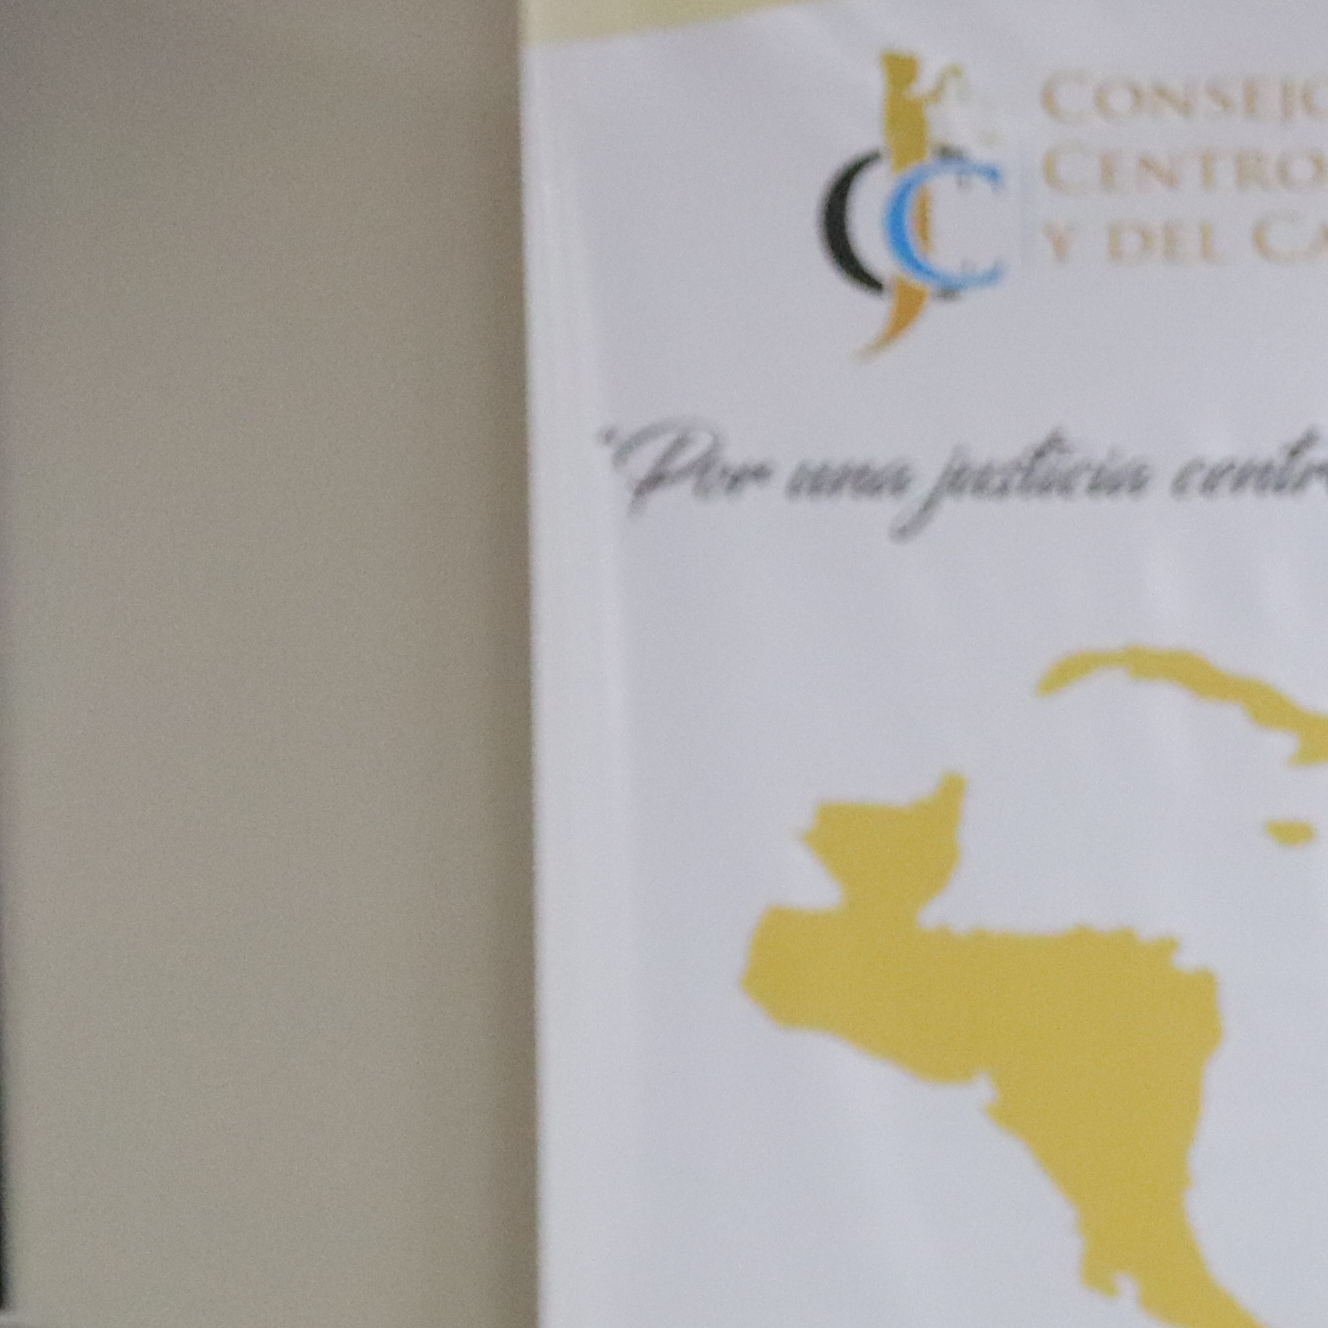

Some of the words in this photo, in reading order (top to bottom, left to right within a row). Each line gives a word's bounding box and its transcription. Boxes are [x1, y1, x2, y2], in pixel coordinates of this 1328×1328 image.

[1041, 220, 1078, 265] Y
[1108, 218, 1228, 265] DEL
[785, 460, 916, 500] una
[888, 425, 1156, 545] justicia
